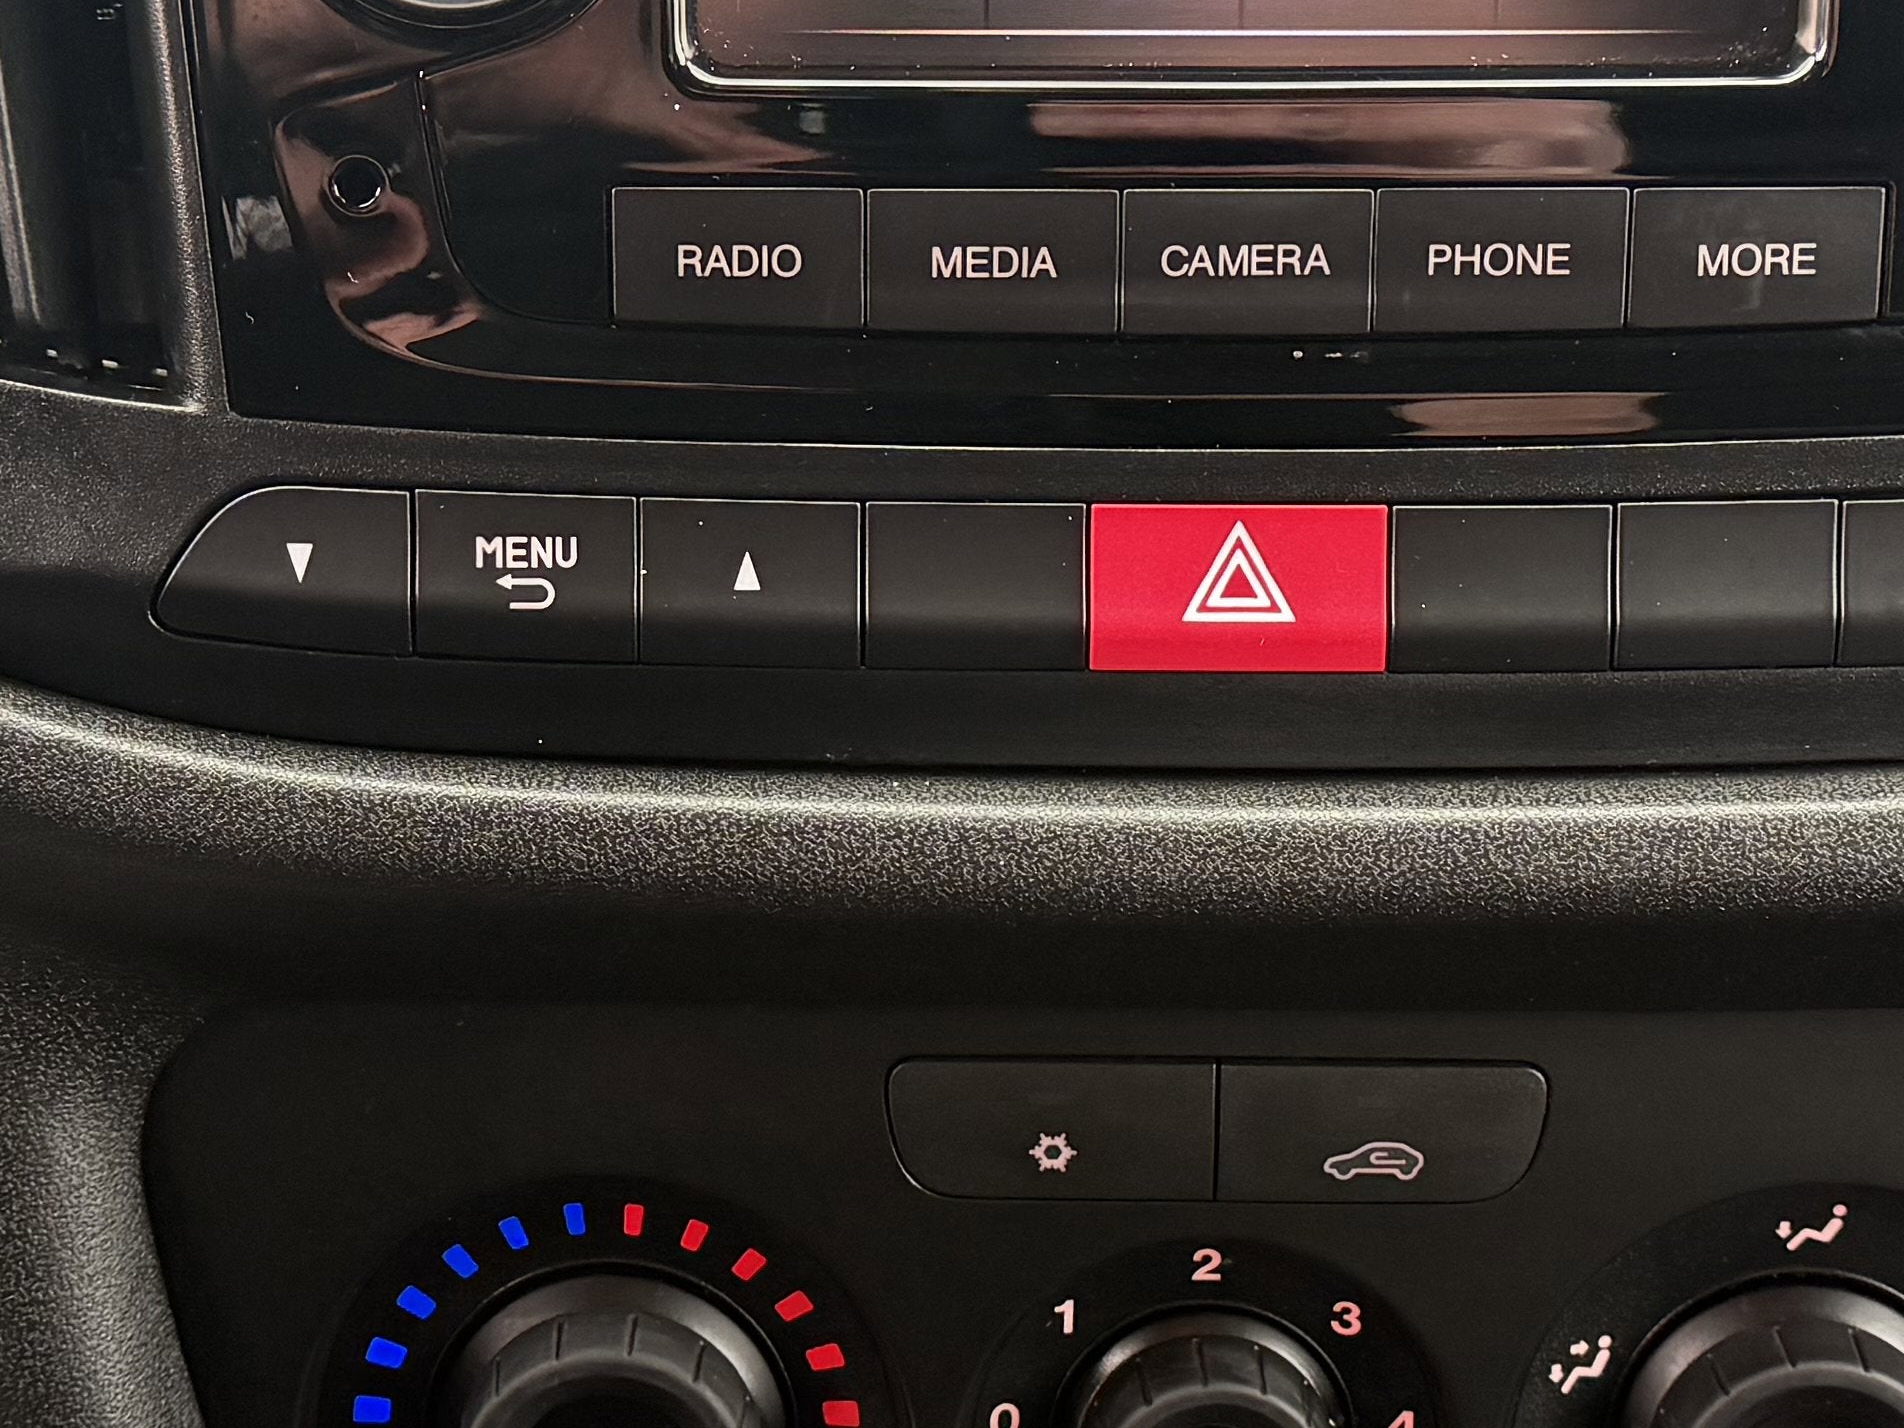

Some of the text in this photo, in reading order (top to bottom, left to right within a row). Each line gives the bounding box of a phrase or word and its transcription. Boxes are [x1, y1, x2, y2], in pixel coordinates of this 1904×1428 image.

[676, 243, 803, 279] RADIO
[930, 245, 1059, 280] MEDIA
[1160, 243, 1332, 278] CAMERA
[1426, 242, 1572, 278] PHONE
[1696, 242, 1818, 278] MORE
[474, 535, 579, 570] MENU
[1191, 1248, 1222, 1281] 2
[1053, 1299, 1076, 1335] 1
[1330, 1300, 1363, 1336] 3
